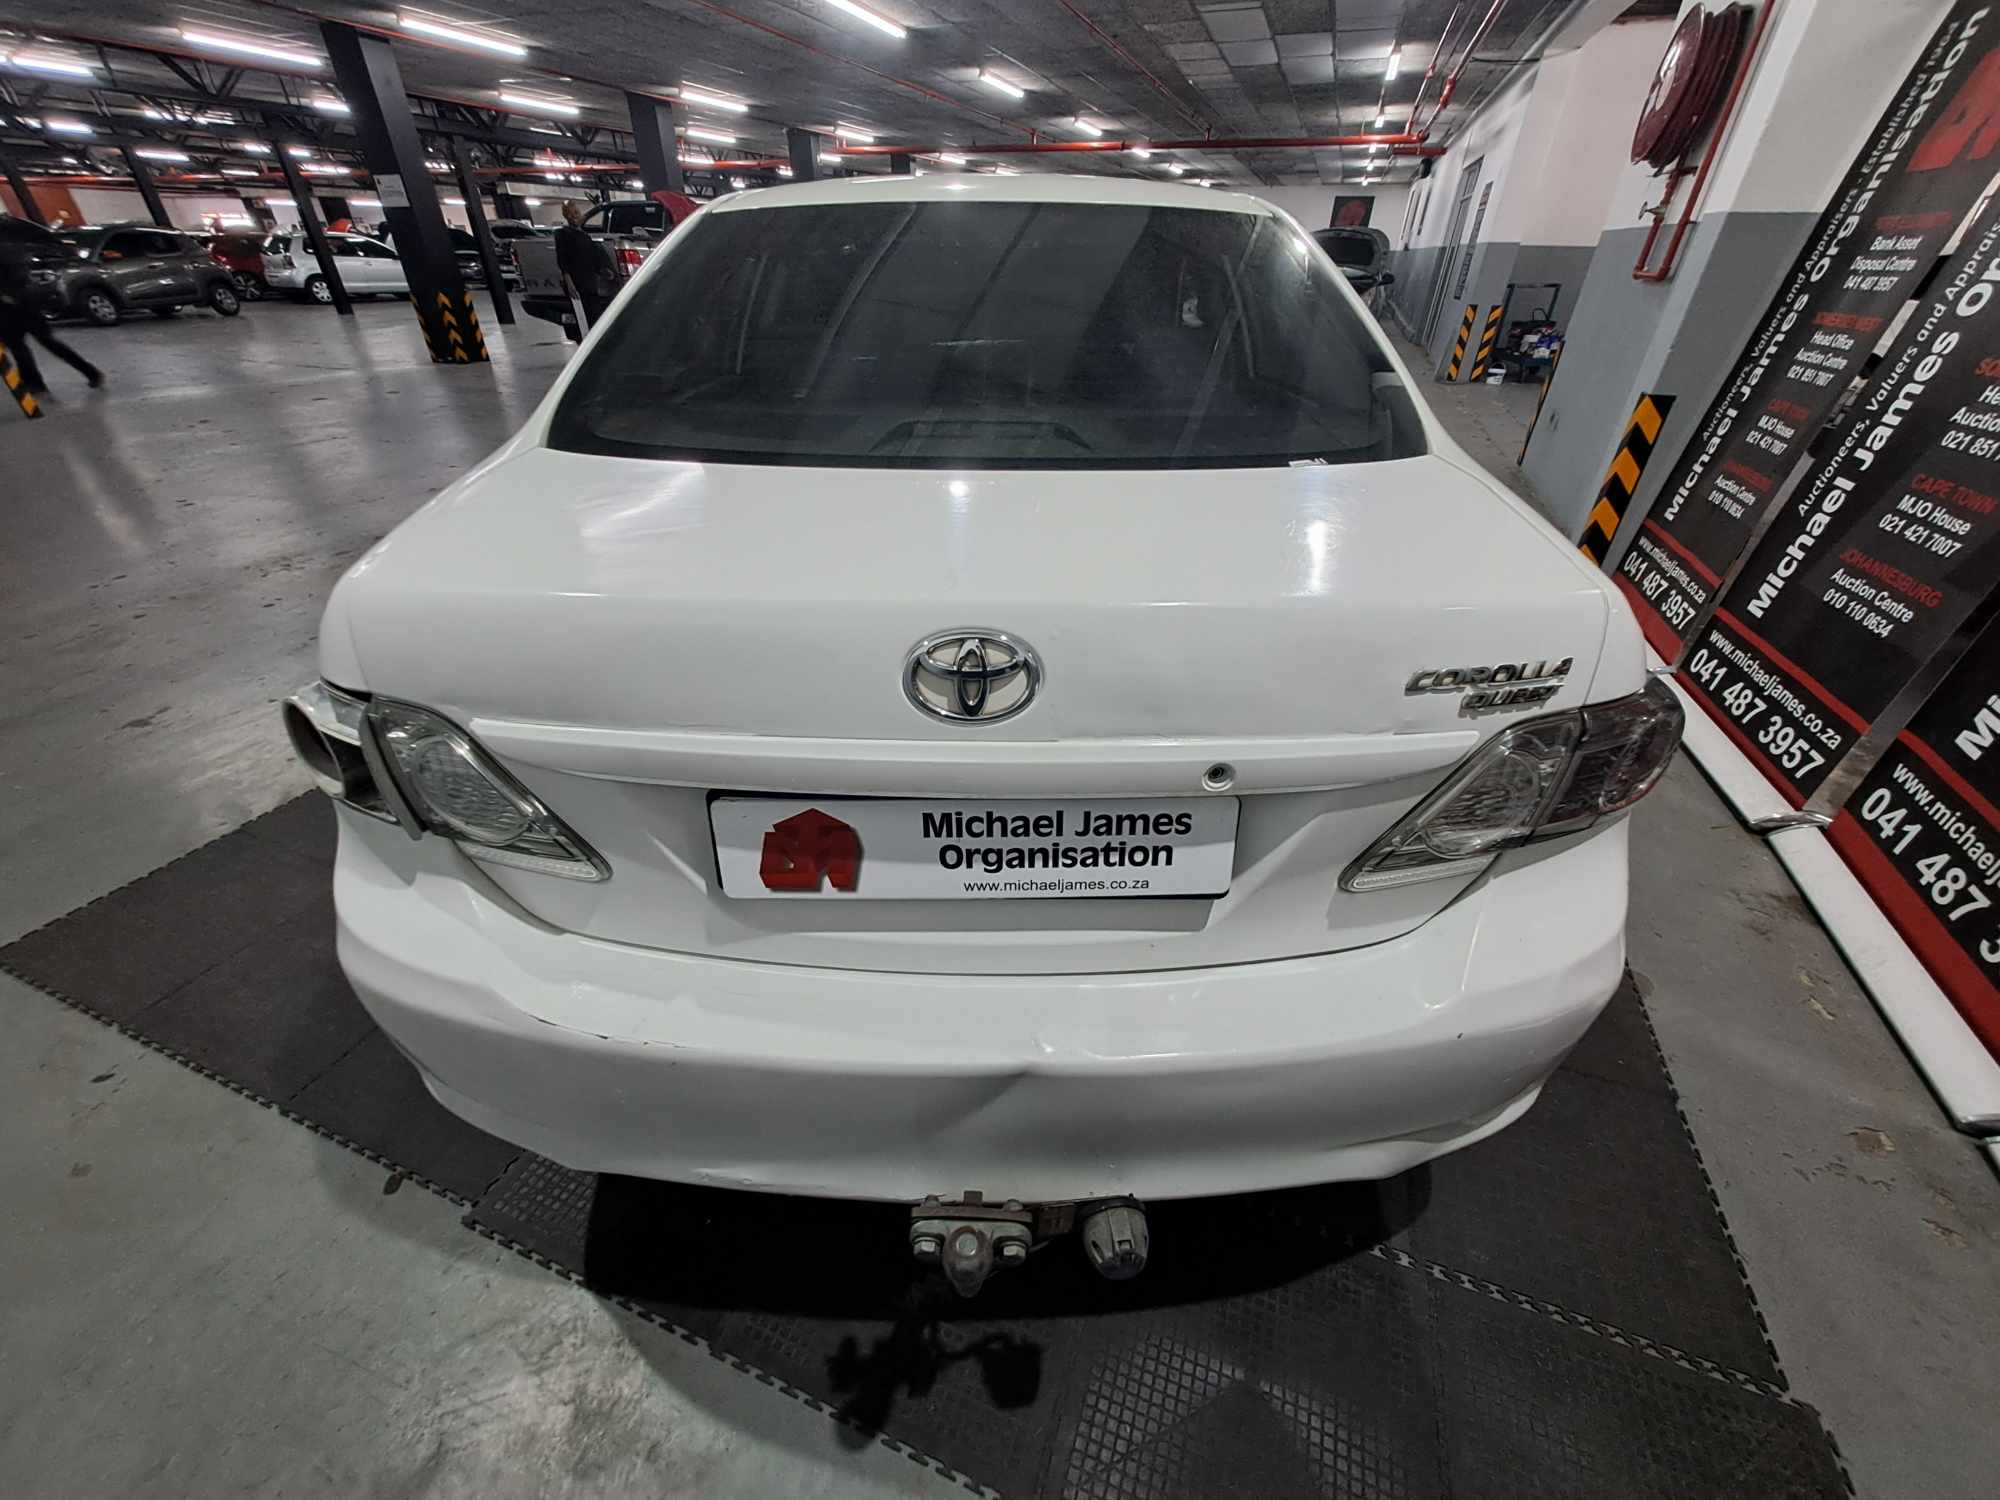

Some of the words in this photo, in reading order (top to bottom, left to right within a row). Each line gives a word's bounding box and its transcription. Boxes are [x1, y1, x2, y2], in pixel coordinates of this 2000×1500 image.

[1751, 306, 1787, 357] Valuers
[1786, 273, 1806, 302] and
[1804, 188, 1858, 271] Appraisers
[1861, 73, 1928, 173] Established
[1664, 408, 1738, 520] Michael
[1740, 293, 1810, 401] James
[1810, 6, 1990, 282] Organisation
[1794, 348, 1825, 365] Auction
[1810, 330, 1833, 346] Head
[1832, 334, 1855, 350] Office
[1798, 419, 1871, 517] Auctioneers,
[1865, 345, 1919, 412] Valuers
[1916, 302, 1947, 342] and
[1941, 430, 1975, 451] 021
[1969, 437, 2000, 458] 851
[1747, 476, 1856, 619] Michael
[1853, 331, 1960, 471] James
[1911, 473, 1954, 498] CAPE
[1878, 513, 1905, 535] 021
[1903, 524, 1930, 545] 421
[1926, 533, 1963, 558] 7007
[1896, 493, 1933, 518] MJO
[1928, 505, 1972, 536] House
[1623, 551, 1648, 582] 041
[1642, 570, 1669, 601] 487
[1661, 589, 1696, 630] 3957
[1638, 535, 1707, 604] www.michaeljames.co.za
[1823, 588, 1848, 609] 010
[1845, 601, 1867, 621] 110
[1862, 612, 1894, 638] 0634
[1830, 568, 1876, 601] Auction
[1874, 591, 1914, 624] Centre
[1404, 656, 1574, 696] COROLLA
[1709, 629, 1842, 750] www.michaeljames.co.za
[1690, 649, 1728, 691] 041
[1722, 682, 1768, 724] 487
[1758, 715, 1826, 779] 3957
[922, 810, 1065, 840] Michael
[1075, 810, 1193, 837] James
[938, 838, 1174, 873] Organisation
[1861, 788, 1922, 855] 041
[1915, 853, 1992, 921] 487
[963, 877, 1150, 894] www.michaeljames.co.za
